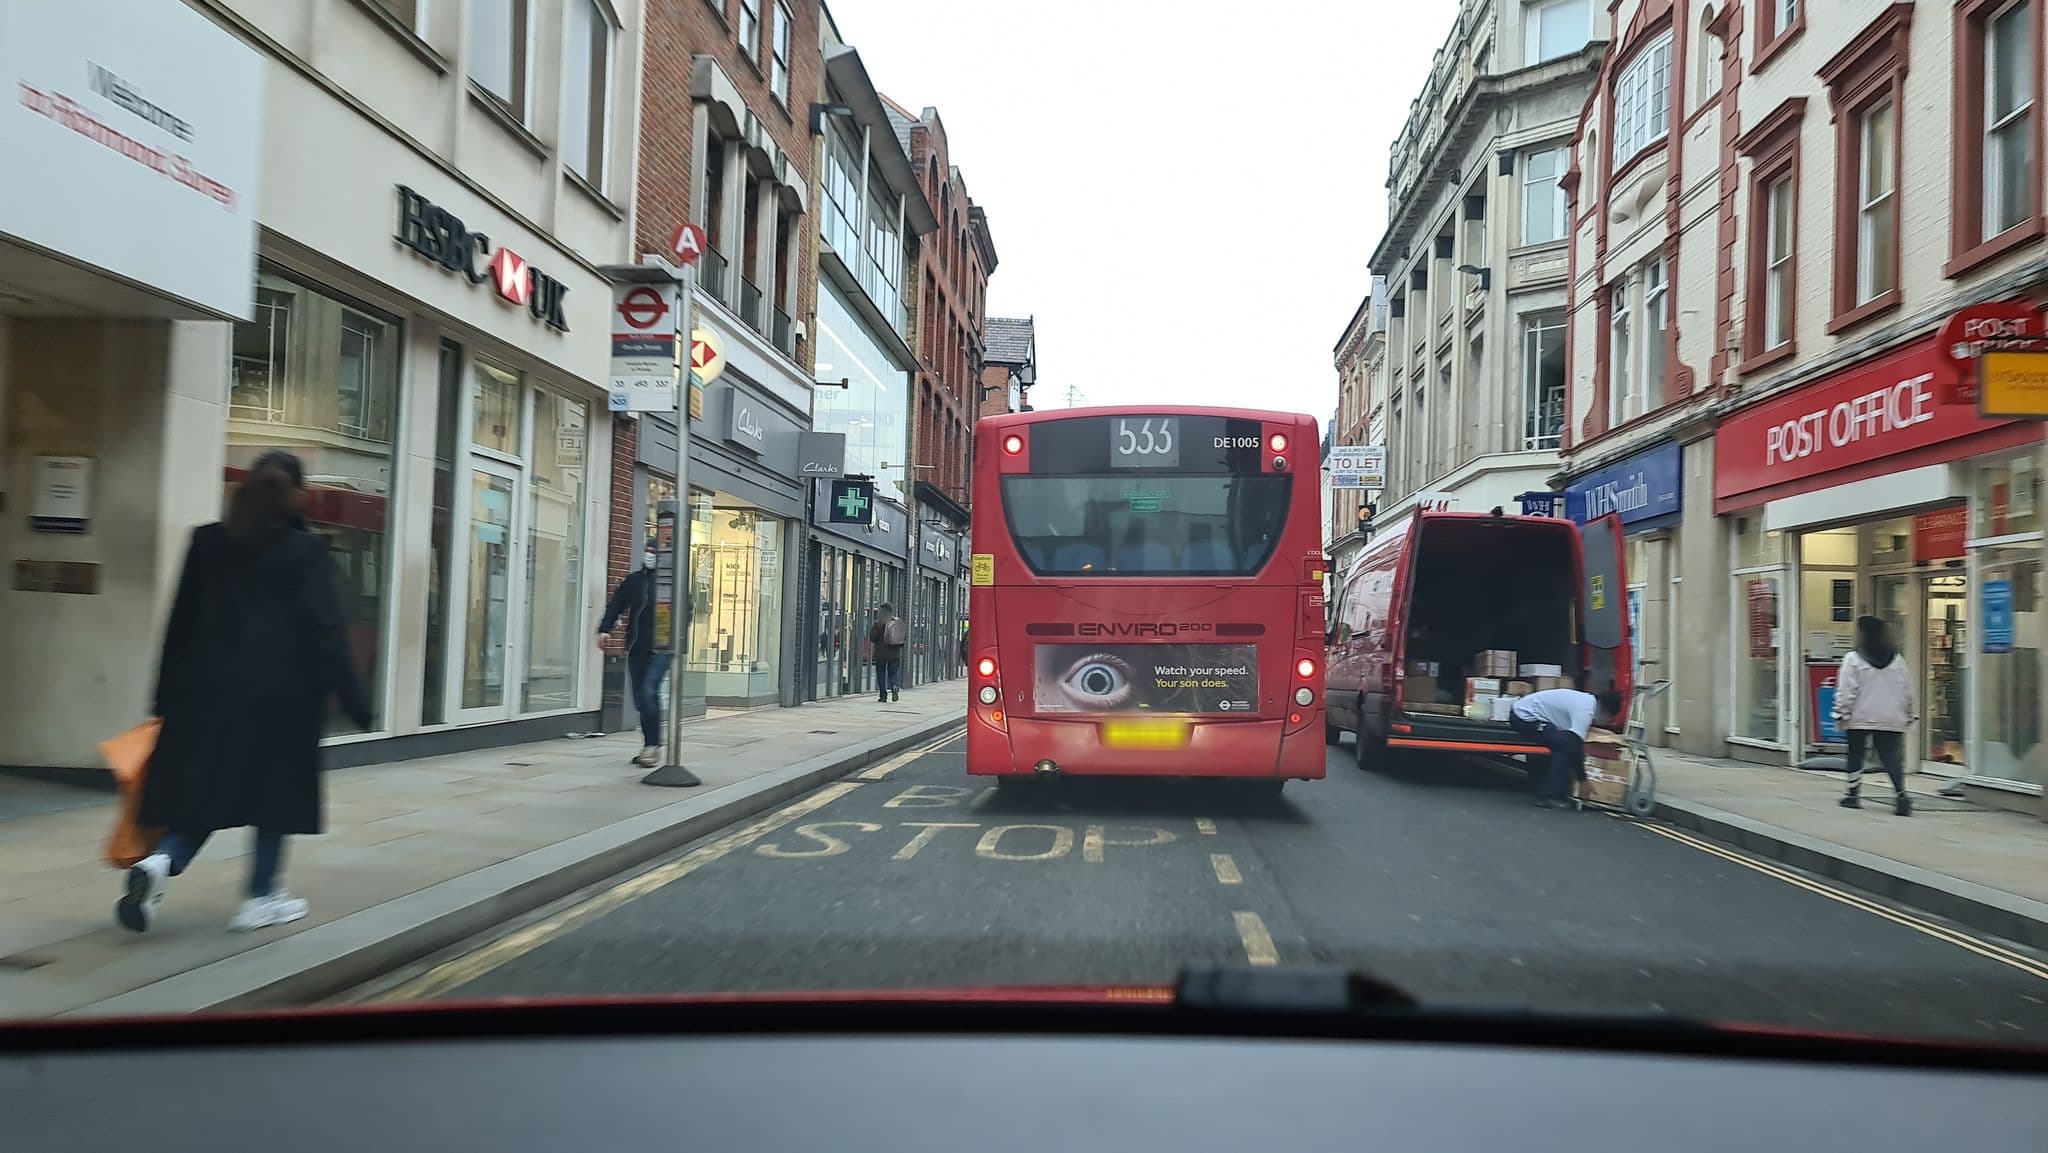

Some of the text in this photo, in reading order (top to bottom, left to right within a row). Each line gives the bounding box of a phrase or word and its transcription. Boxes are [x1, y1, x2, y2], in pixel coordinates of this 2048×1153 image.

[675, 226, 700, 254] A
[393, 183, 570, 333] HSBC UK
[1965, 317, 2032, 338] POST
[1766, 372, 1934, 466] POST OFFICE
[1213, 437, 1259, 448] DE1005
[803, 462, 839, 473] Clarks
[1334, 458, 1382, 468] TO LET
[1154, 666, 1249, 677] Watch your speed.
[1155, 679, 1178, 687] Your
[1201, 679, 1229, 687] does.
[757, 821, 1178, 864] STOP
